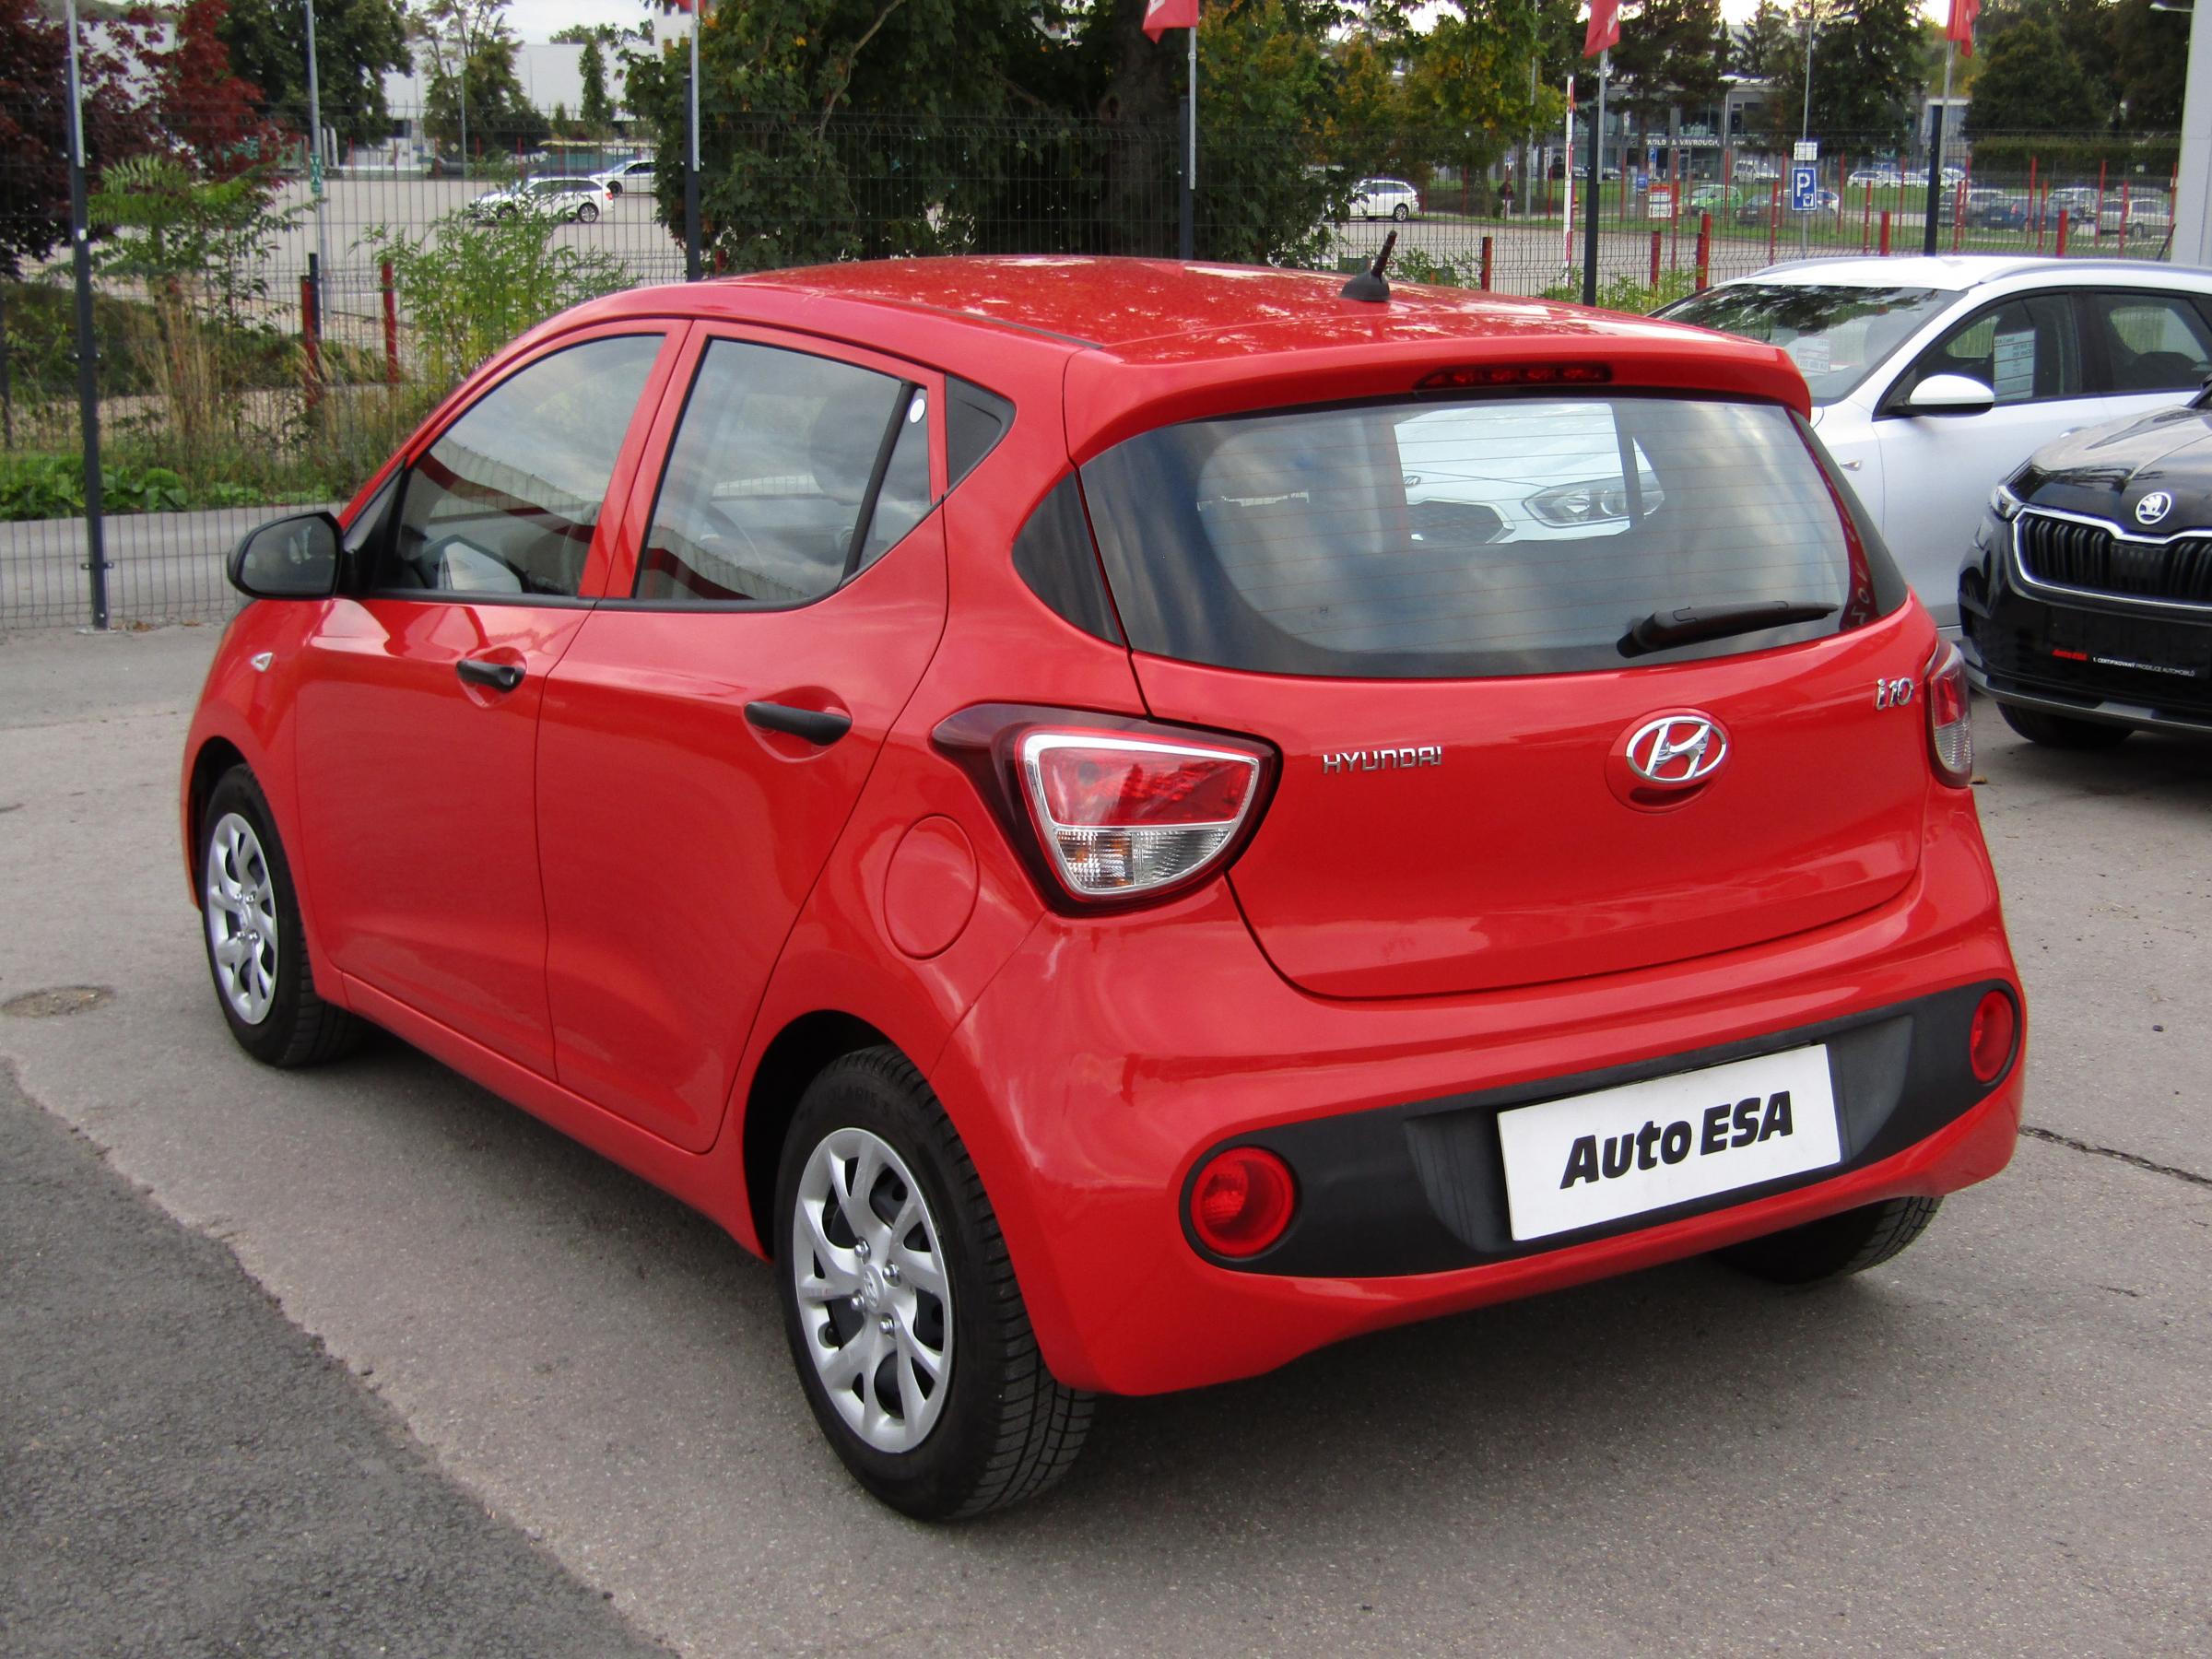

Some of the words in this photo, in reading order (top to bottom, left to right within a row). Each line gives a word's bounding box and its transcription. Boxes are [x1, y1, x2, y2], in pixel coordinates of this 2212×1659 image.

[1796, 172, 1811, 197] P
[1876, 677, 1914, 712] i10
[1323, 745, 1442, 774] HYUNDAI
[1559, 1120, 1692, 1190] Auto
[1700, 1090, 1794, 1157] ESA
